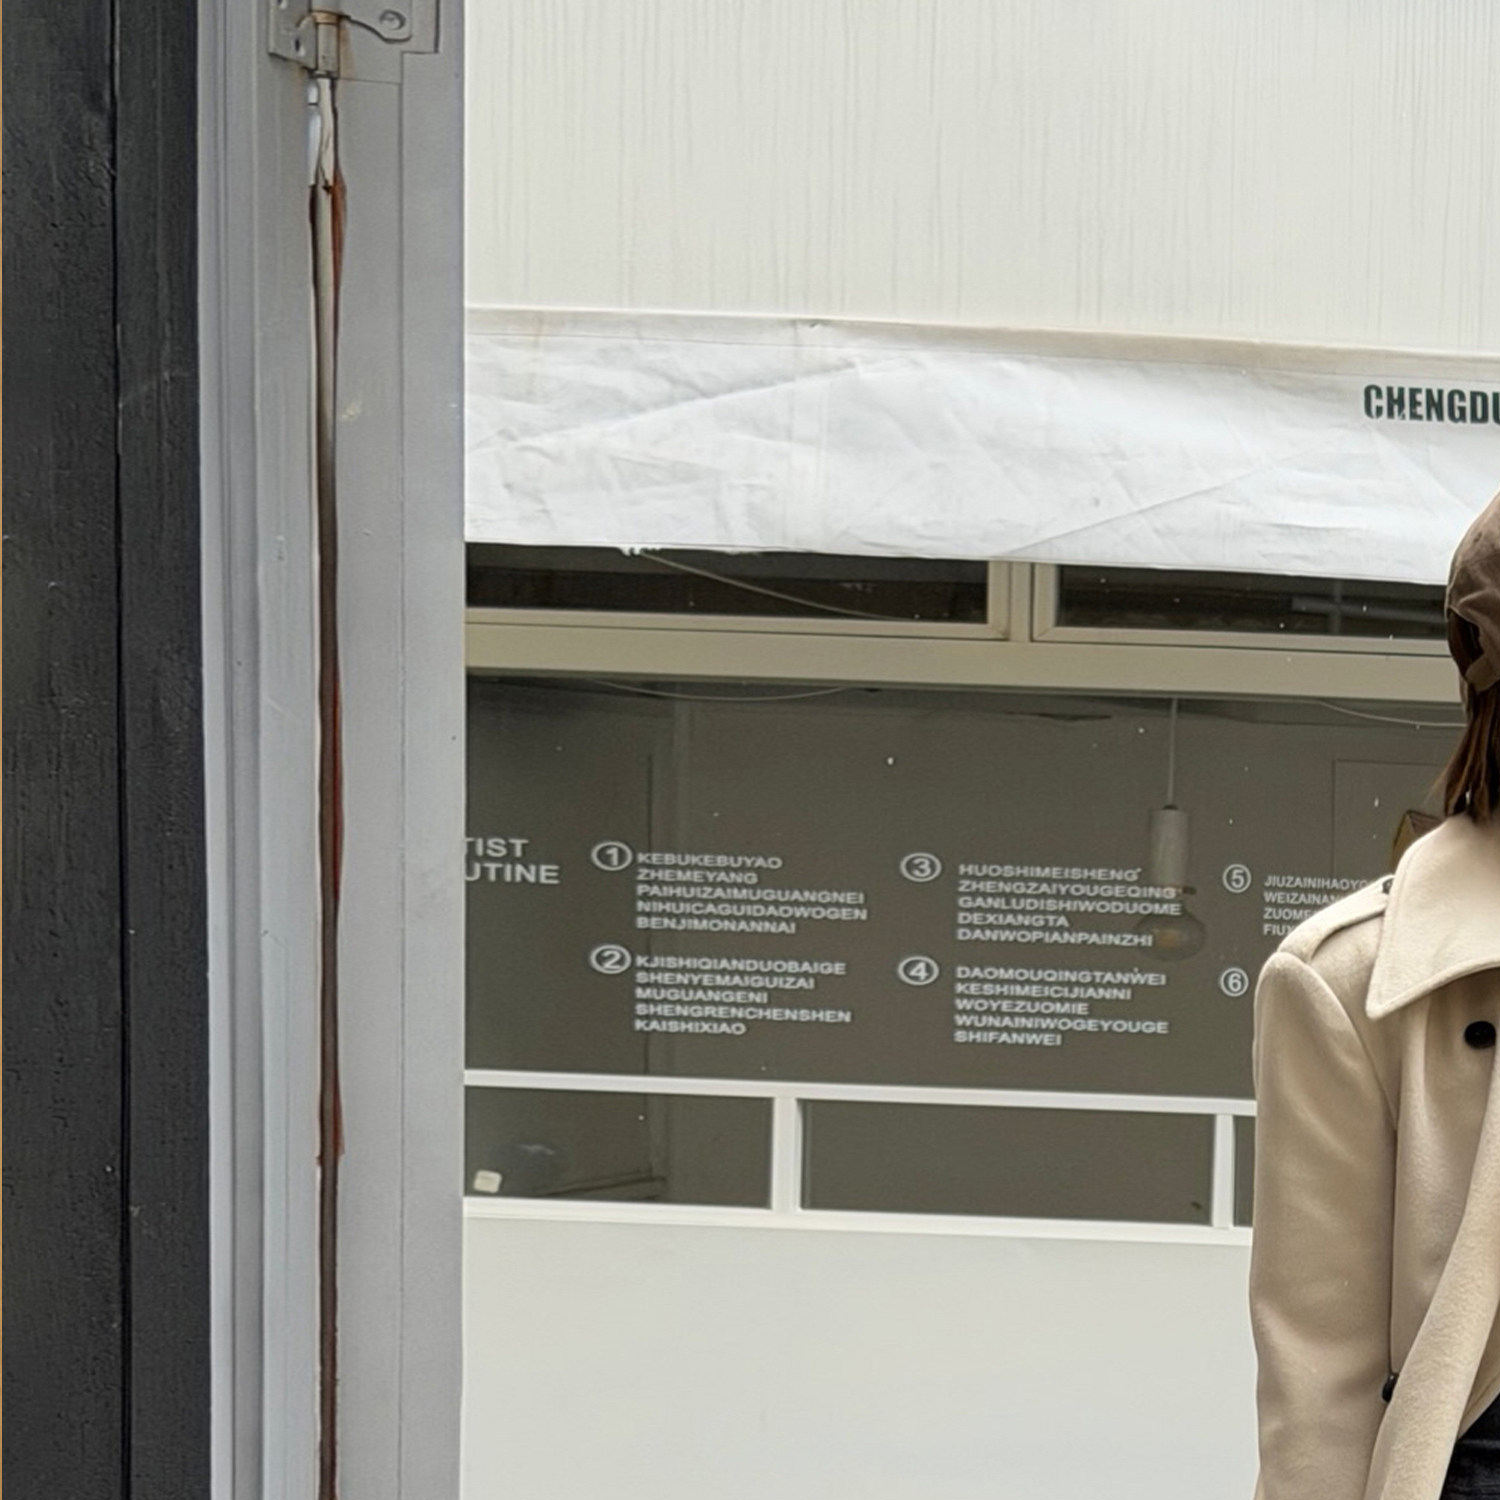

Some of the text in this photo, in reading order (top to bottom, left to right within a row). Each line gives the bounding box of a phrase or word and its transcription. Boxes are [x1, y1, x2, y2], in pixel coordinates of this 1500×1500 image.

[636, 868, 758, 885] ZHEMEYANG
[957, 912, 1070, 928] DEXIANGTA
[954, 998, 1090, 1015] WOYEZUOMIE
[953, 1030, 1062, 1046] SHIFANWEI
